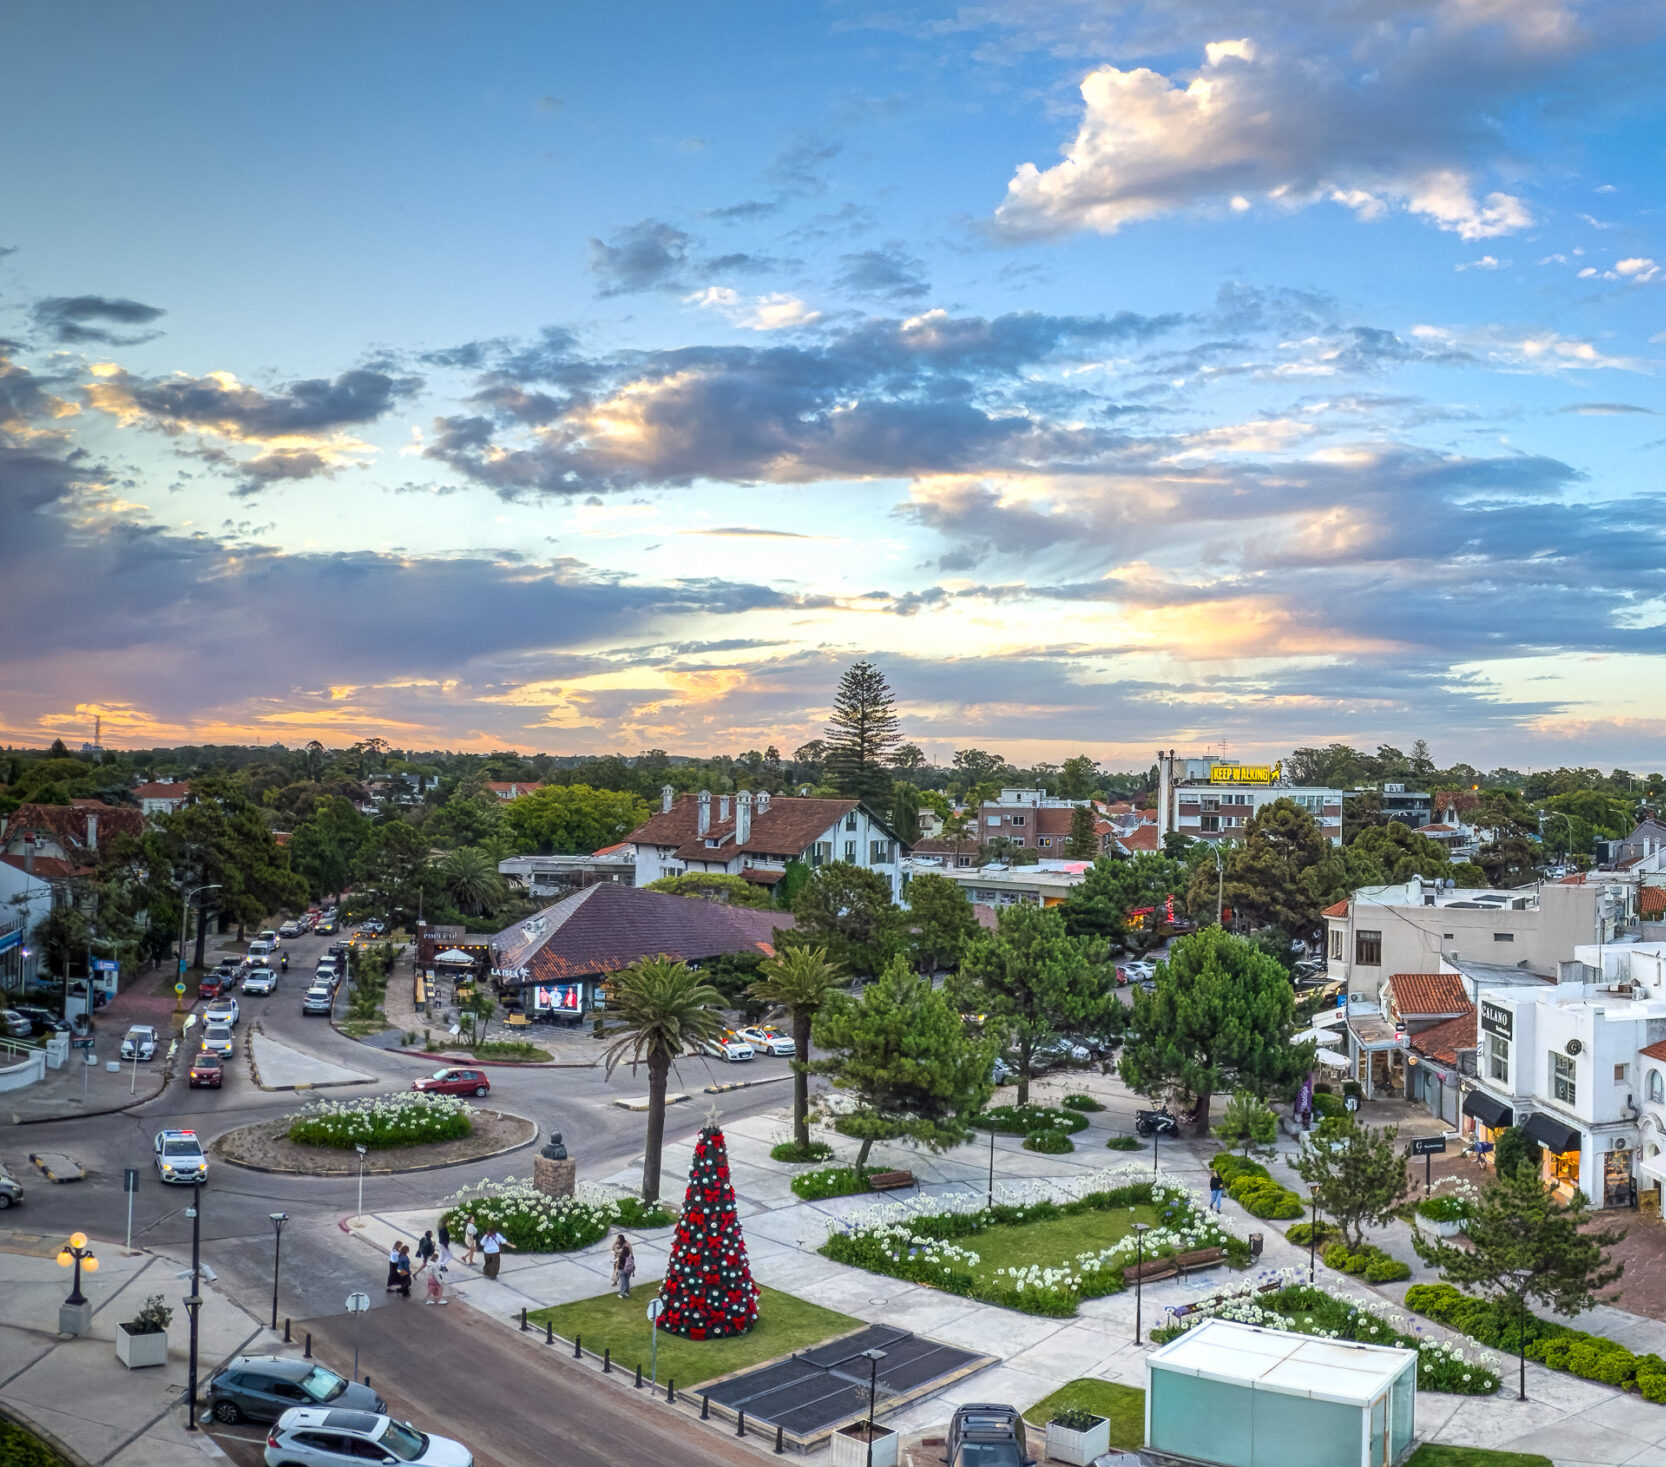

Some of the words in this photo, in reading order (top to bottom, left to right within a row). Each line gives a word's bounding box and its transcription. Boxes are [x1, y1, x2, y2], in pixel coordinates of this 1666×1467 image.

[1213, 767, 1232, 781] KEEP
[1232, 767, 1268, 781] WALKING
[491, 967, 501, 977] LA
[502, 969, 520, 979] ISLA
